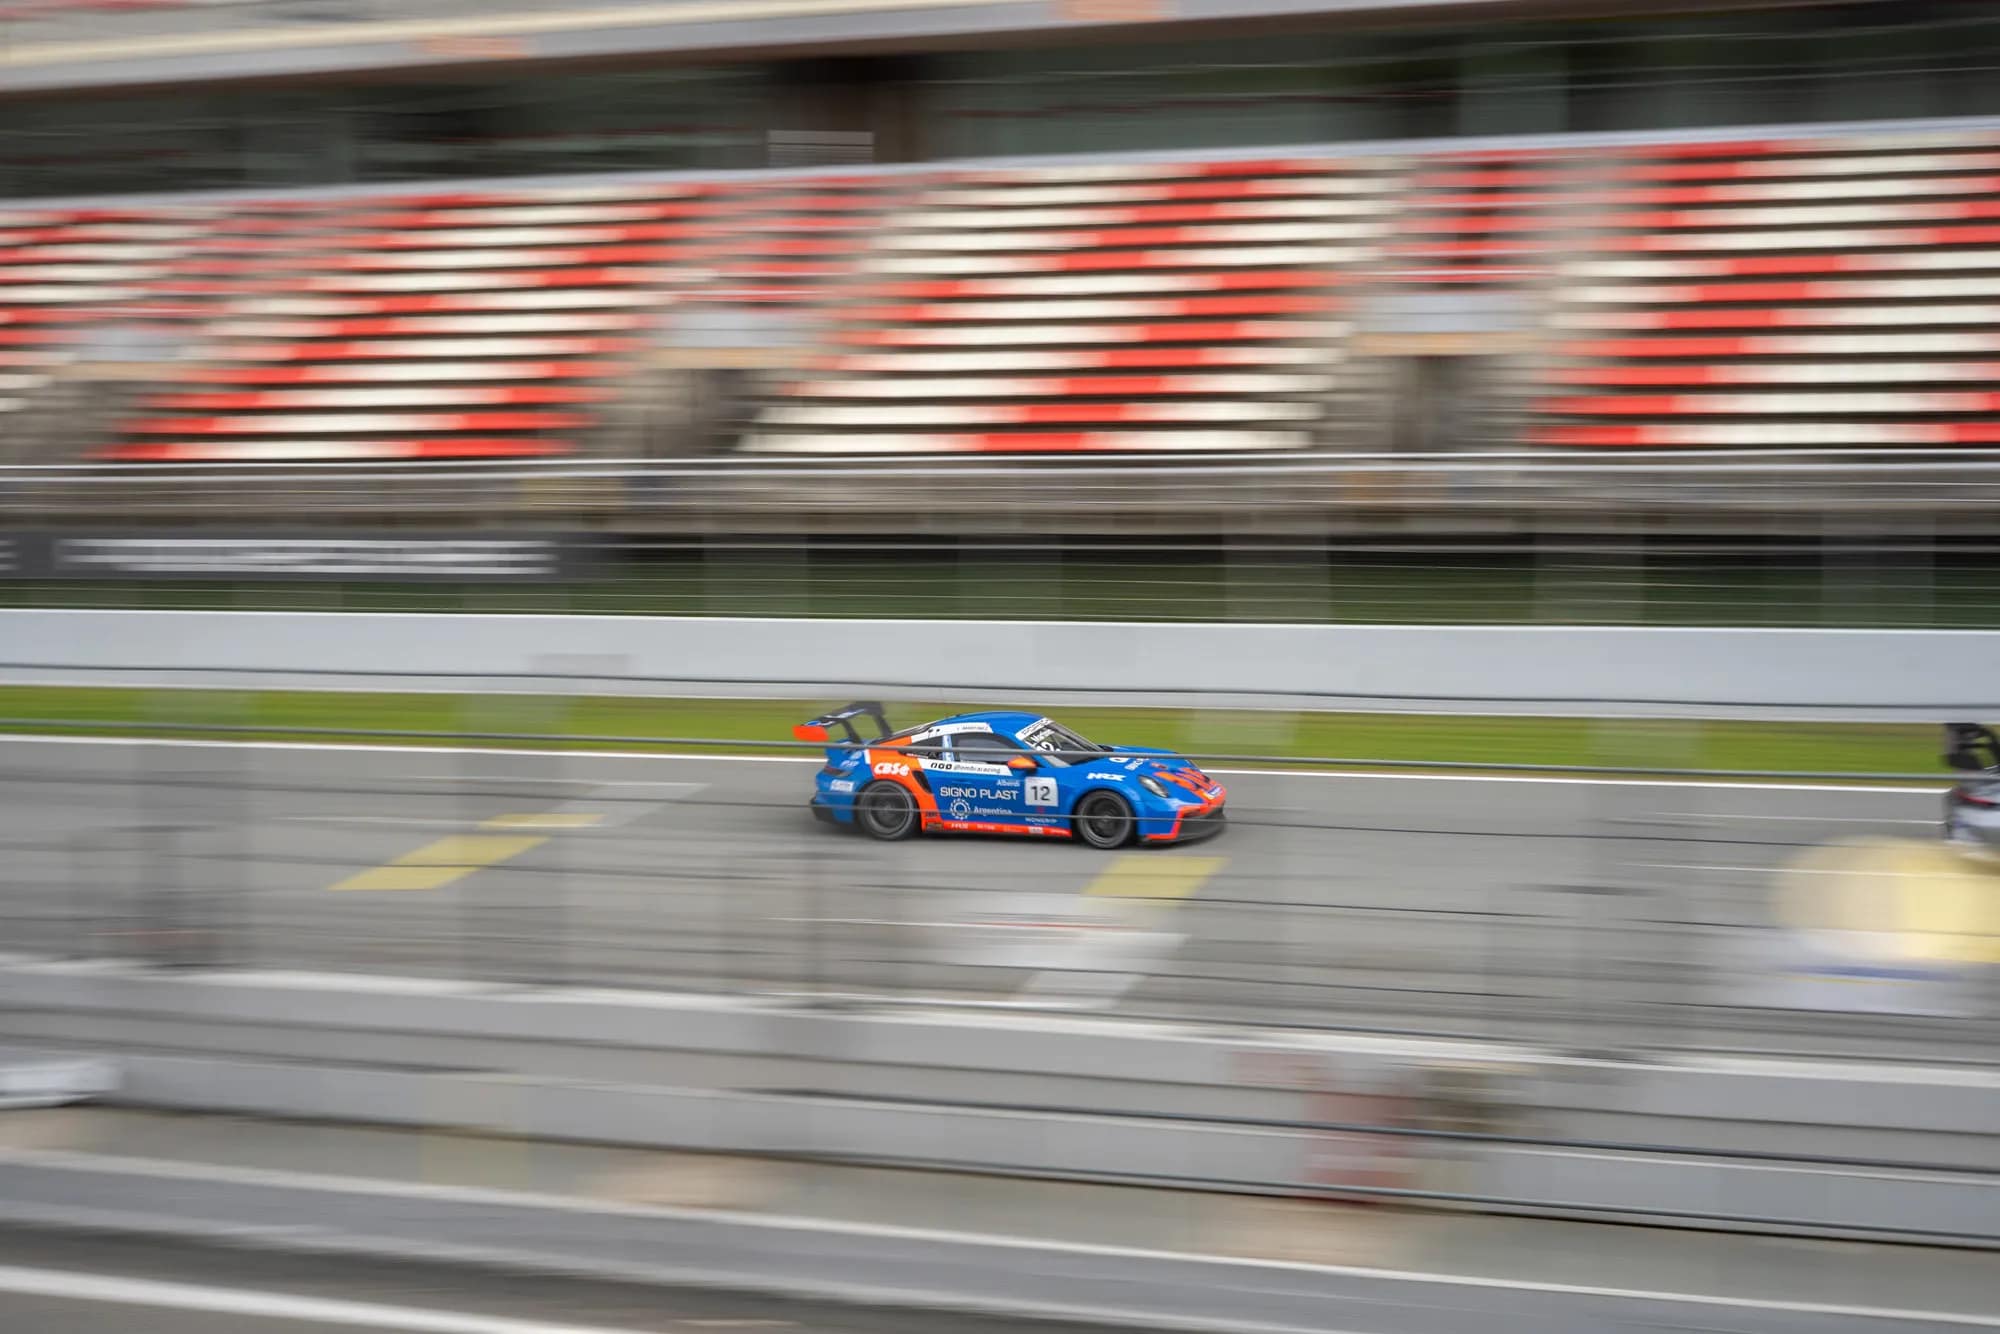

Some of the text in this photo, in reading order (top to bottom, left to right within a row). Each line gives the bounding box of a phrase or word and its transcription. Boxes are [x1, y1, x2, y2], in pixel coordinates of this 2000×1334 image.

[940, 786, 1019, 800] SIGNO PLAST
[1031, 785, 1051, 801] 12
[974, 806, 1014, 816] Argentina
